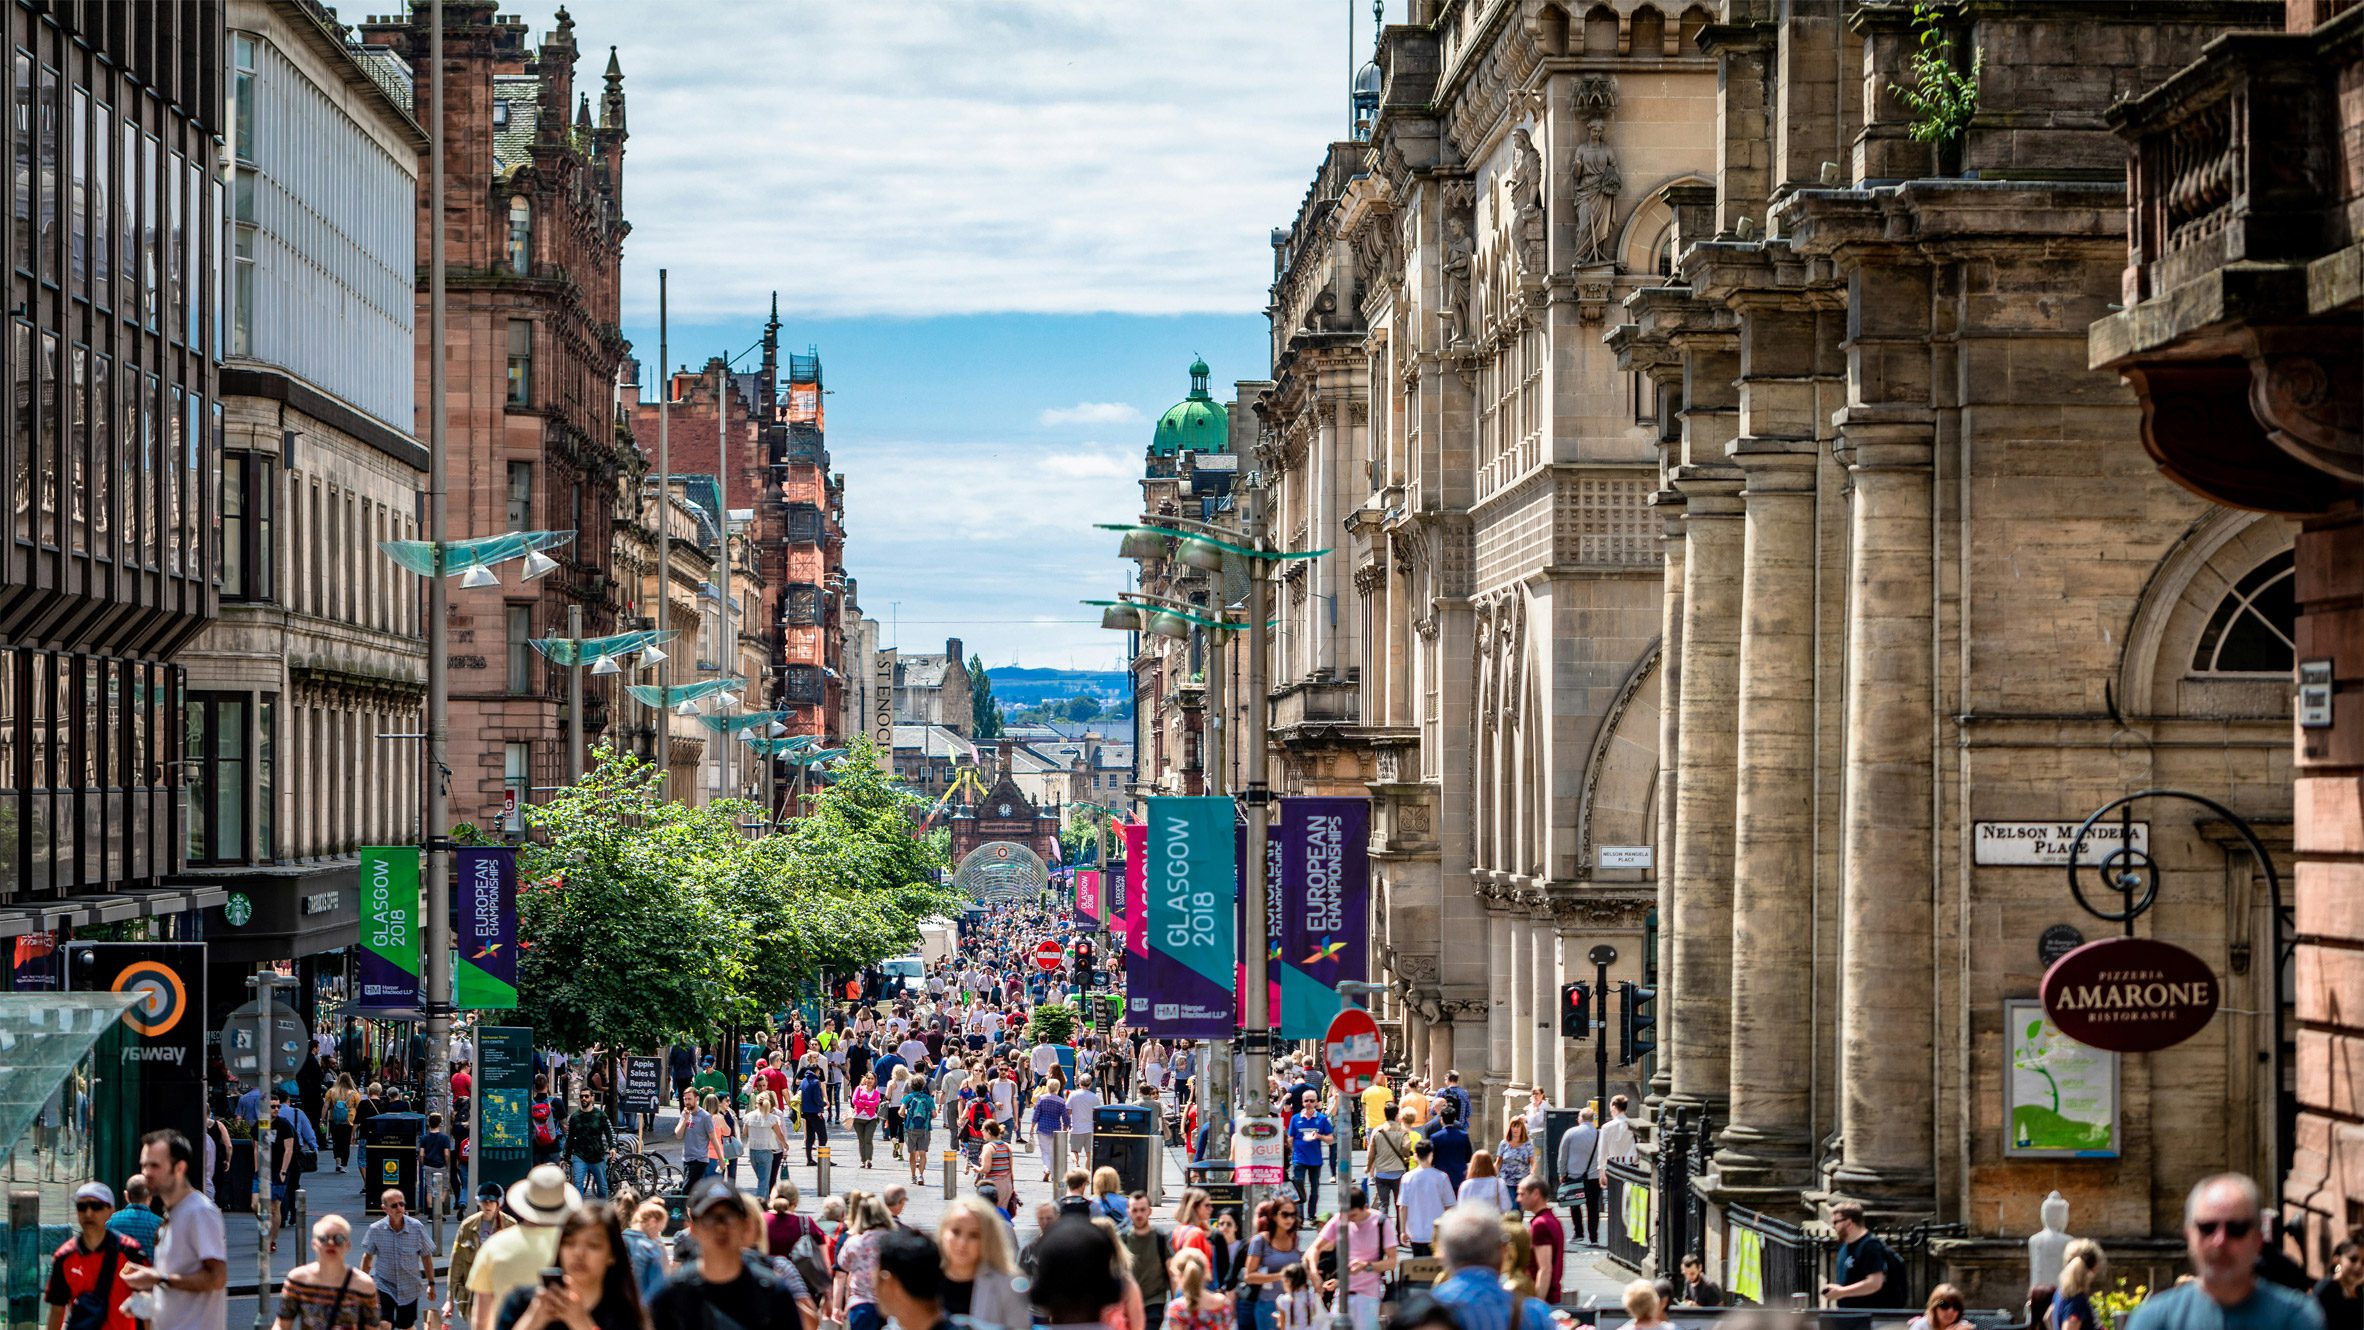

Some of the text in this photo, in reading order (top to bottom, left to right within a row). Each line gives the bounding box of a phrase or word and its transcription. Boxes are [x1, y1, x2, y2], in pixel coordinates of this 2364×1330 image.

[877, 661, 891, 680] ST
[1983, 825, 2139, 840] NELSON MNDEA
[1167, 816, 1189, 947] GLASGOW
[1307, 816, 1327, 931] EUROPEAN
[1328, 816, 1342, 931] CHAMPIONSHIPS
[373, 859, 389, 947] GLASGOW
[475, 859, 489, 936] EUROPEAN
[489, 859, 499, 936] CHAMPIONSHIPS
[390, 909, 405, 946] 2018
[1192, 891, 1215, 947] 2018
[2098, 970, 2165, 981] PIZZERIA
[2056, 982, 2209, 1010] AMARONE
[2088, 1010, 2177, 1022] RISTORANTE
[633, 1060, 655, 1069] Apple
[630, 1080, 656, 1088] Repairs
